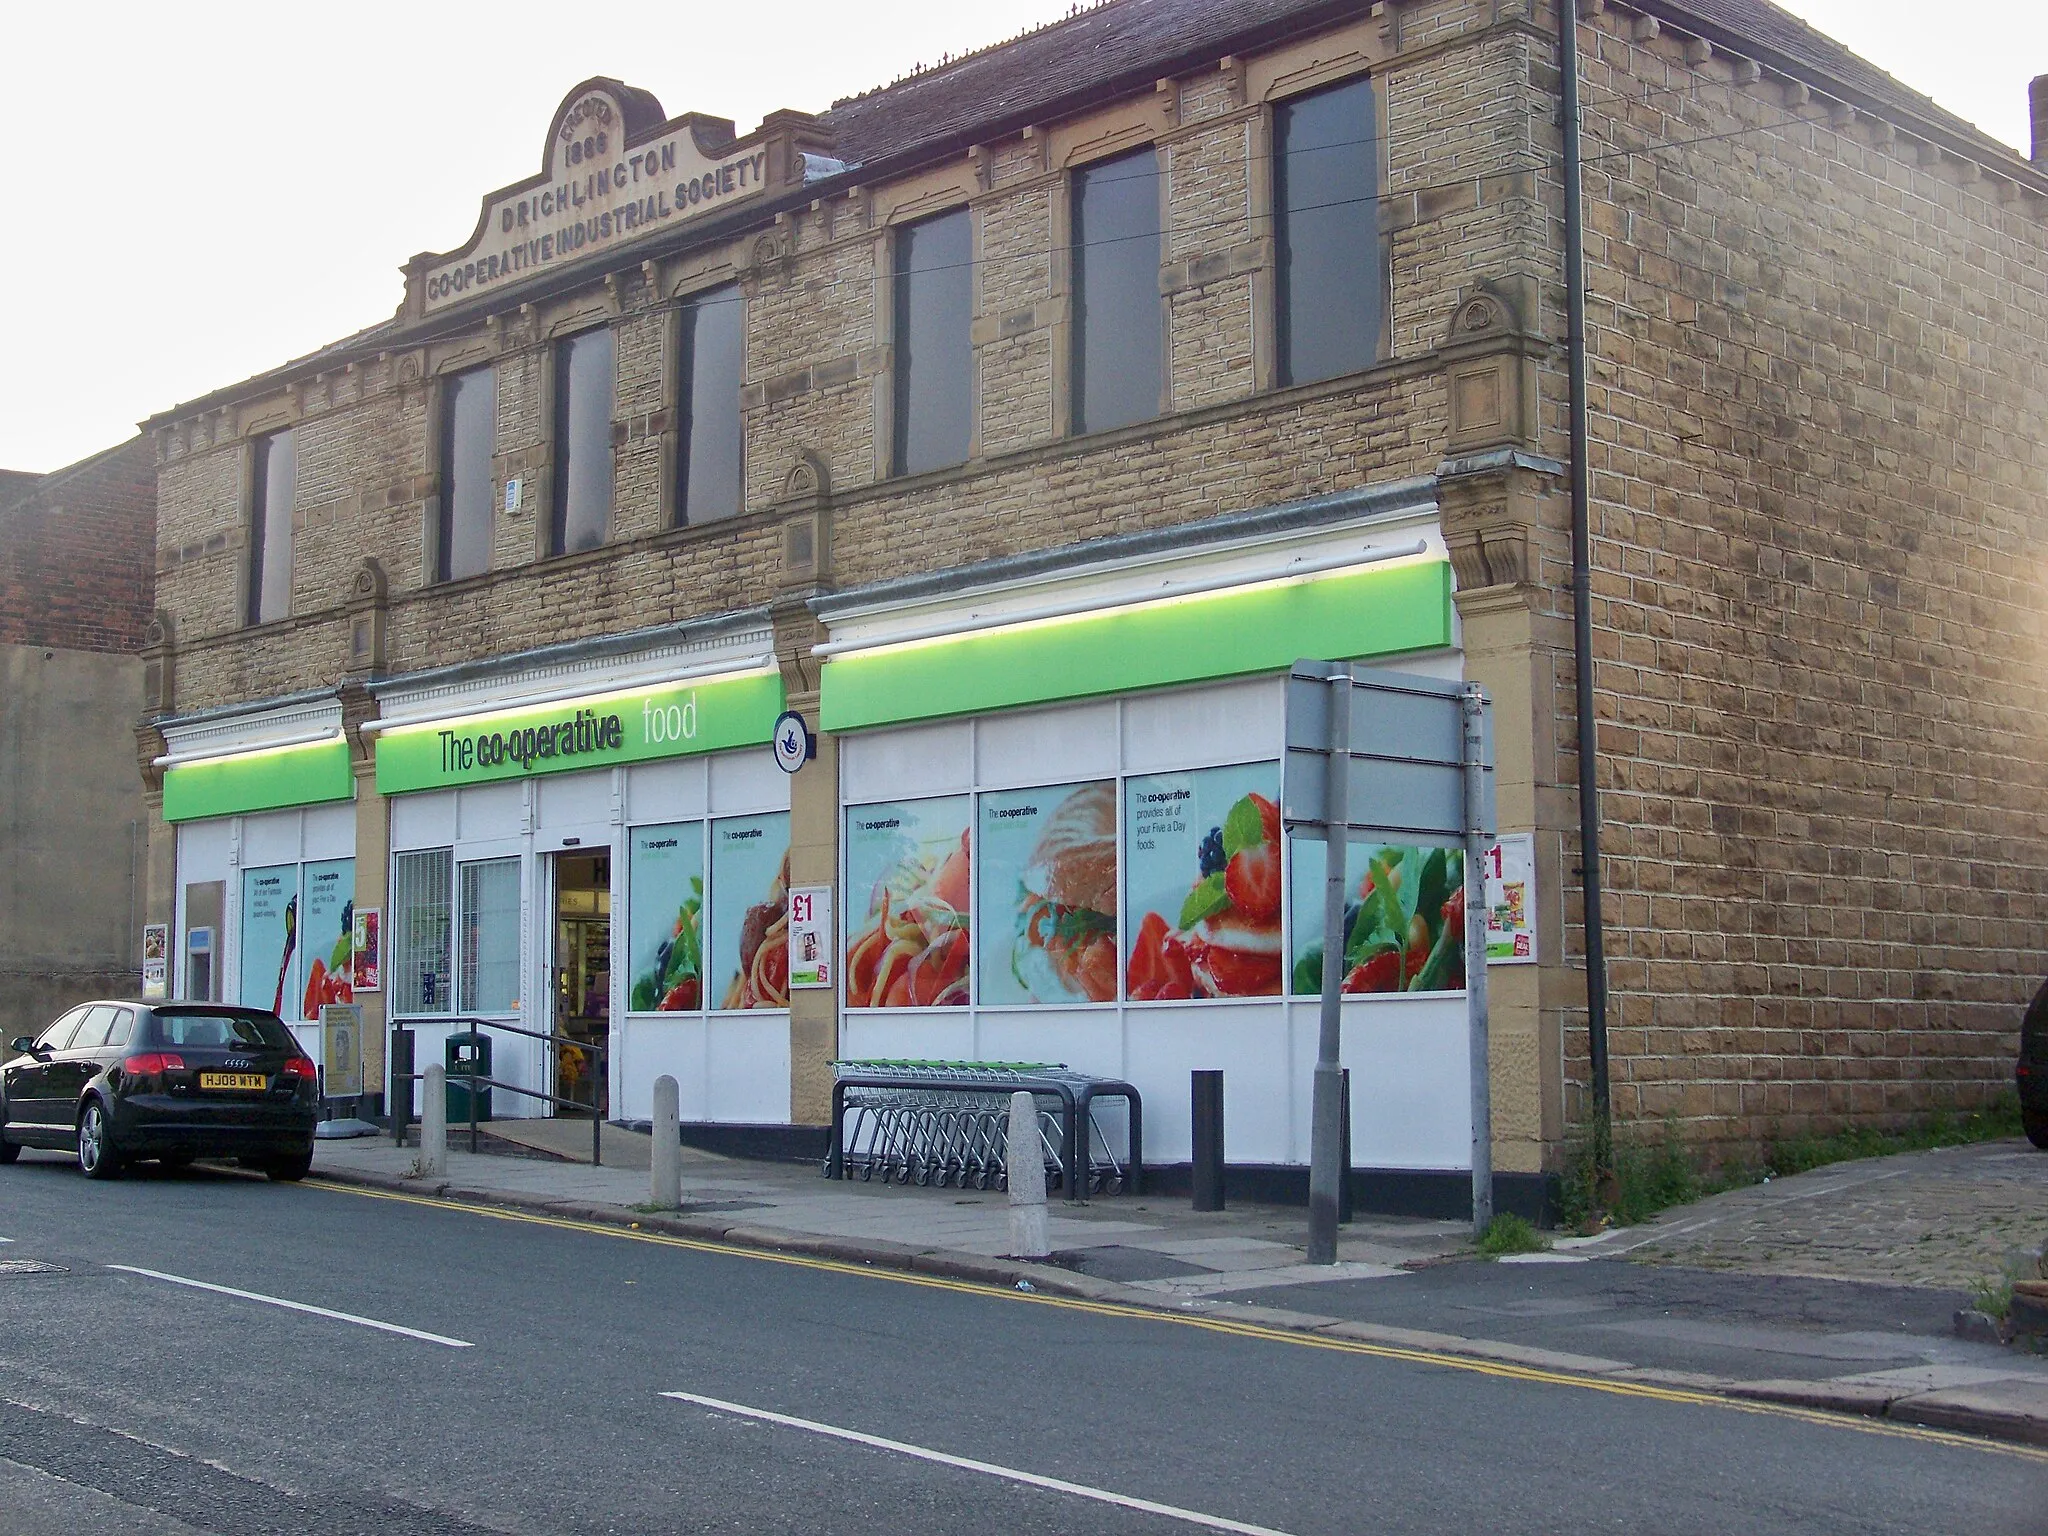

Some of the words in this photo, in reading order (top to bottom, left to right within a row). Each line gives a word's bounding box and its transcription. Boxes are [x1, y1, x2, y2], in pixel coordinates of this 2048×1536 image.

[427, 232, 554, 301] CO-OPERATIVE
[555, 191, 671, 255] INDUSTRIAL
[675, 151, 765, 210] SOCIETY
[438, 730, 473, 773] The
[477, 708, 623, 769] co-operative
[642, 691, 697, 744] food
[1136, 793, 1147, 803] The
[1148, 789, 1191, 803] co-operative
[988, 808, 999, 818] The
[1000, 805, 1038, 819] co-operative
[1136, 807, 1163, 821] provides
[865, 818, 900, 830] co-operative
[1136, 825, 1151, 837] your
[1152, 822, 1165, 833] Five
[1173, 820, 1186, 833] Day
[793, 894, 812, 922] £1
